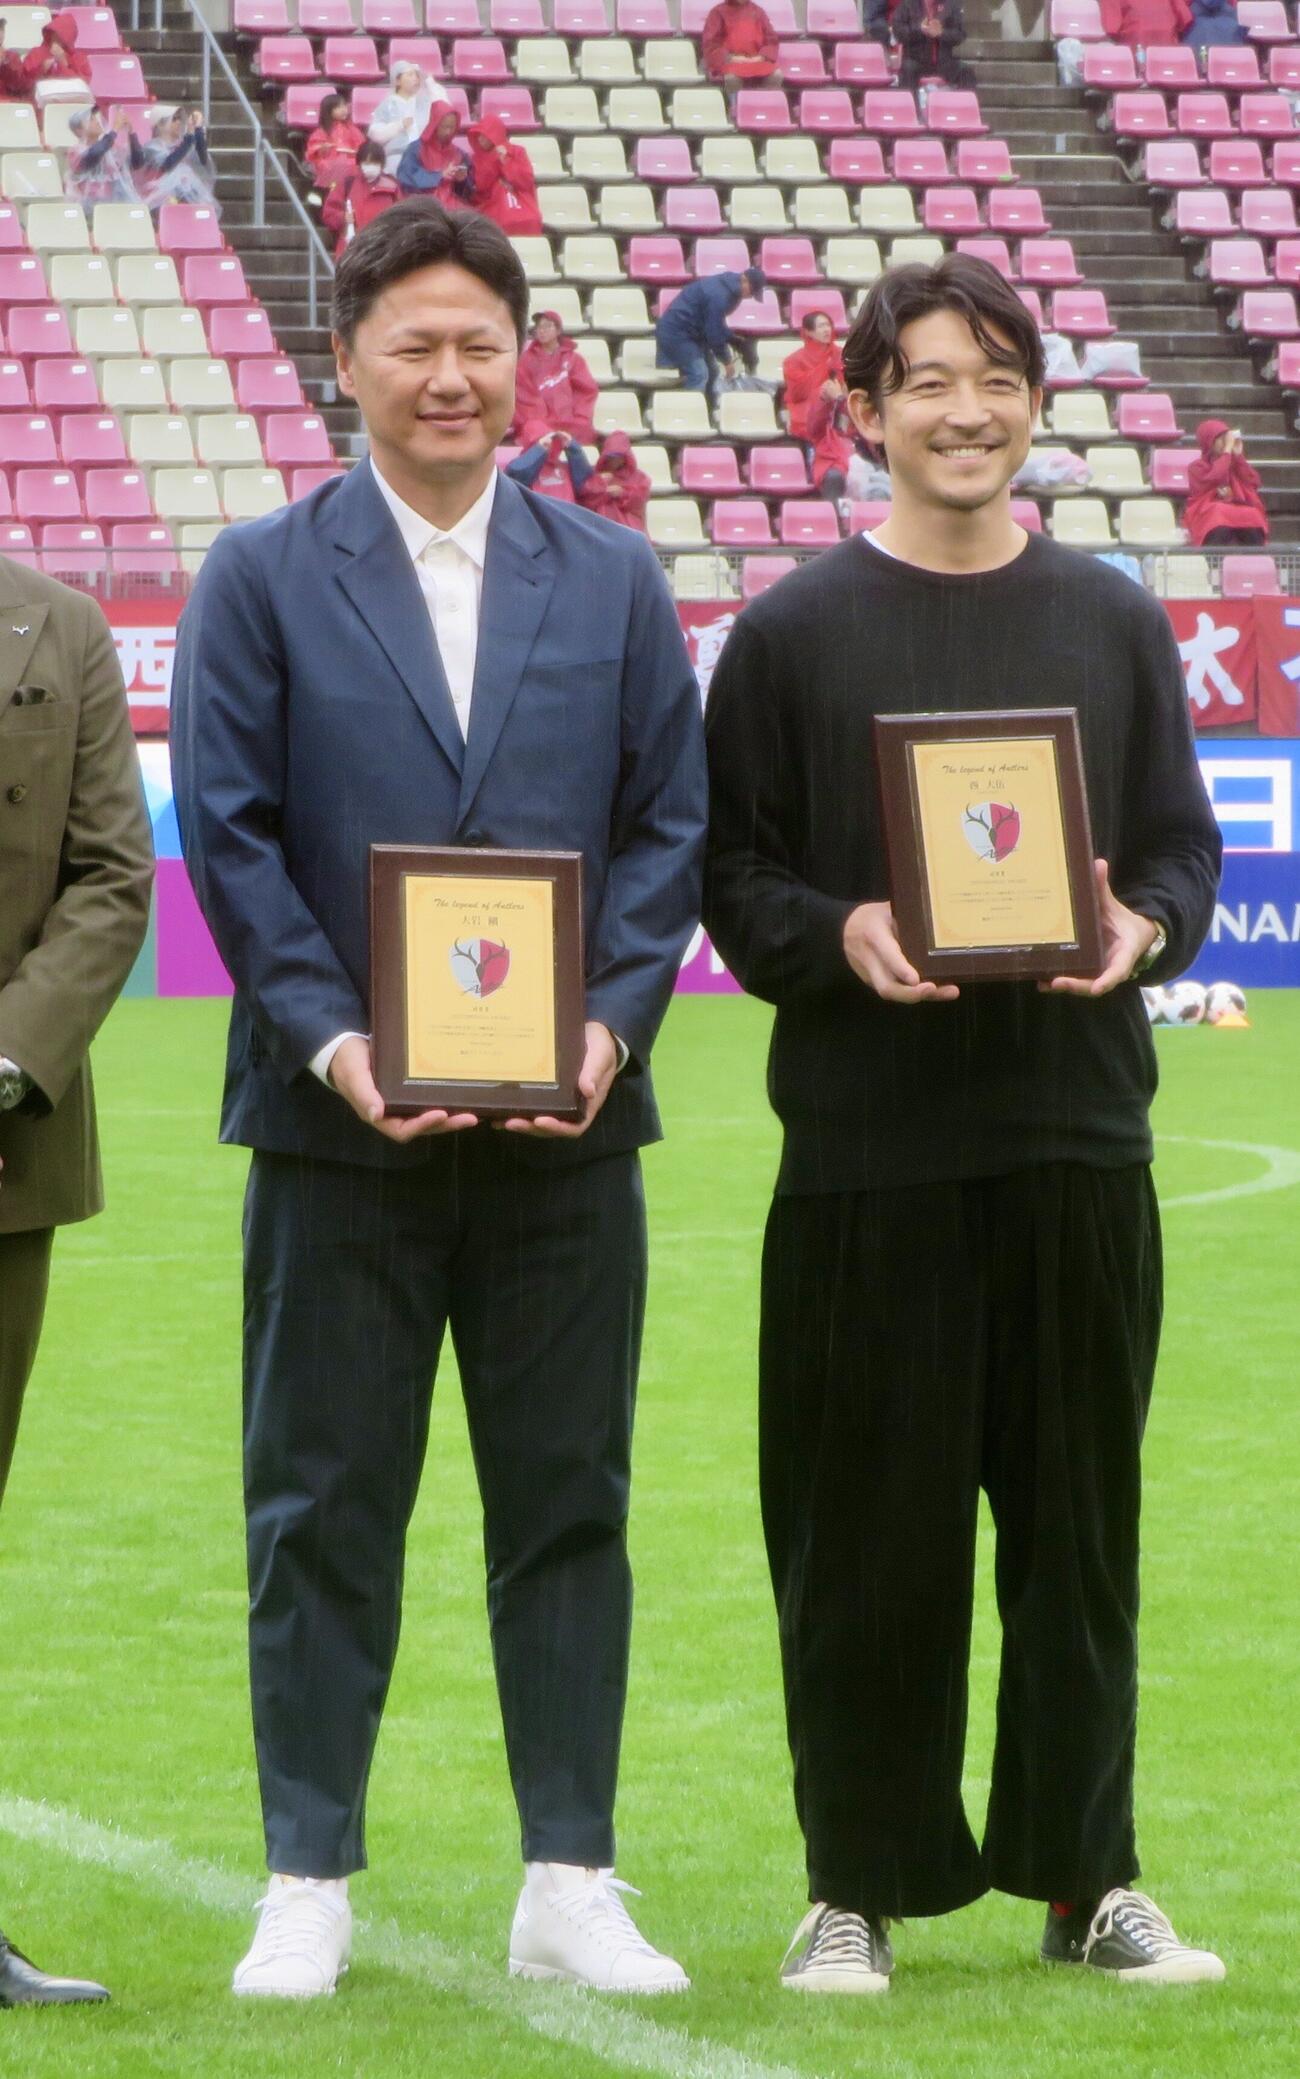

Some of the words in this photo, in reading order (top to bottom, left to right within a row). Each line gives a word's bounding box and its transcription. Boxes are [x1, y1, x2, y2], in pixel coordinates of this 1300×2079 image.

[942, 765, 956, 774] The
[988, 765, 995, 775] of
[434, 898, 449, 907] The
[482, 902, 490, 911] of
